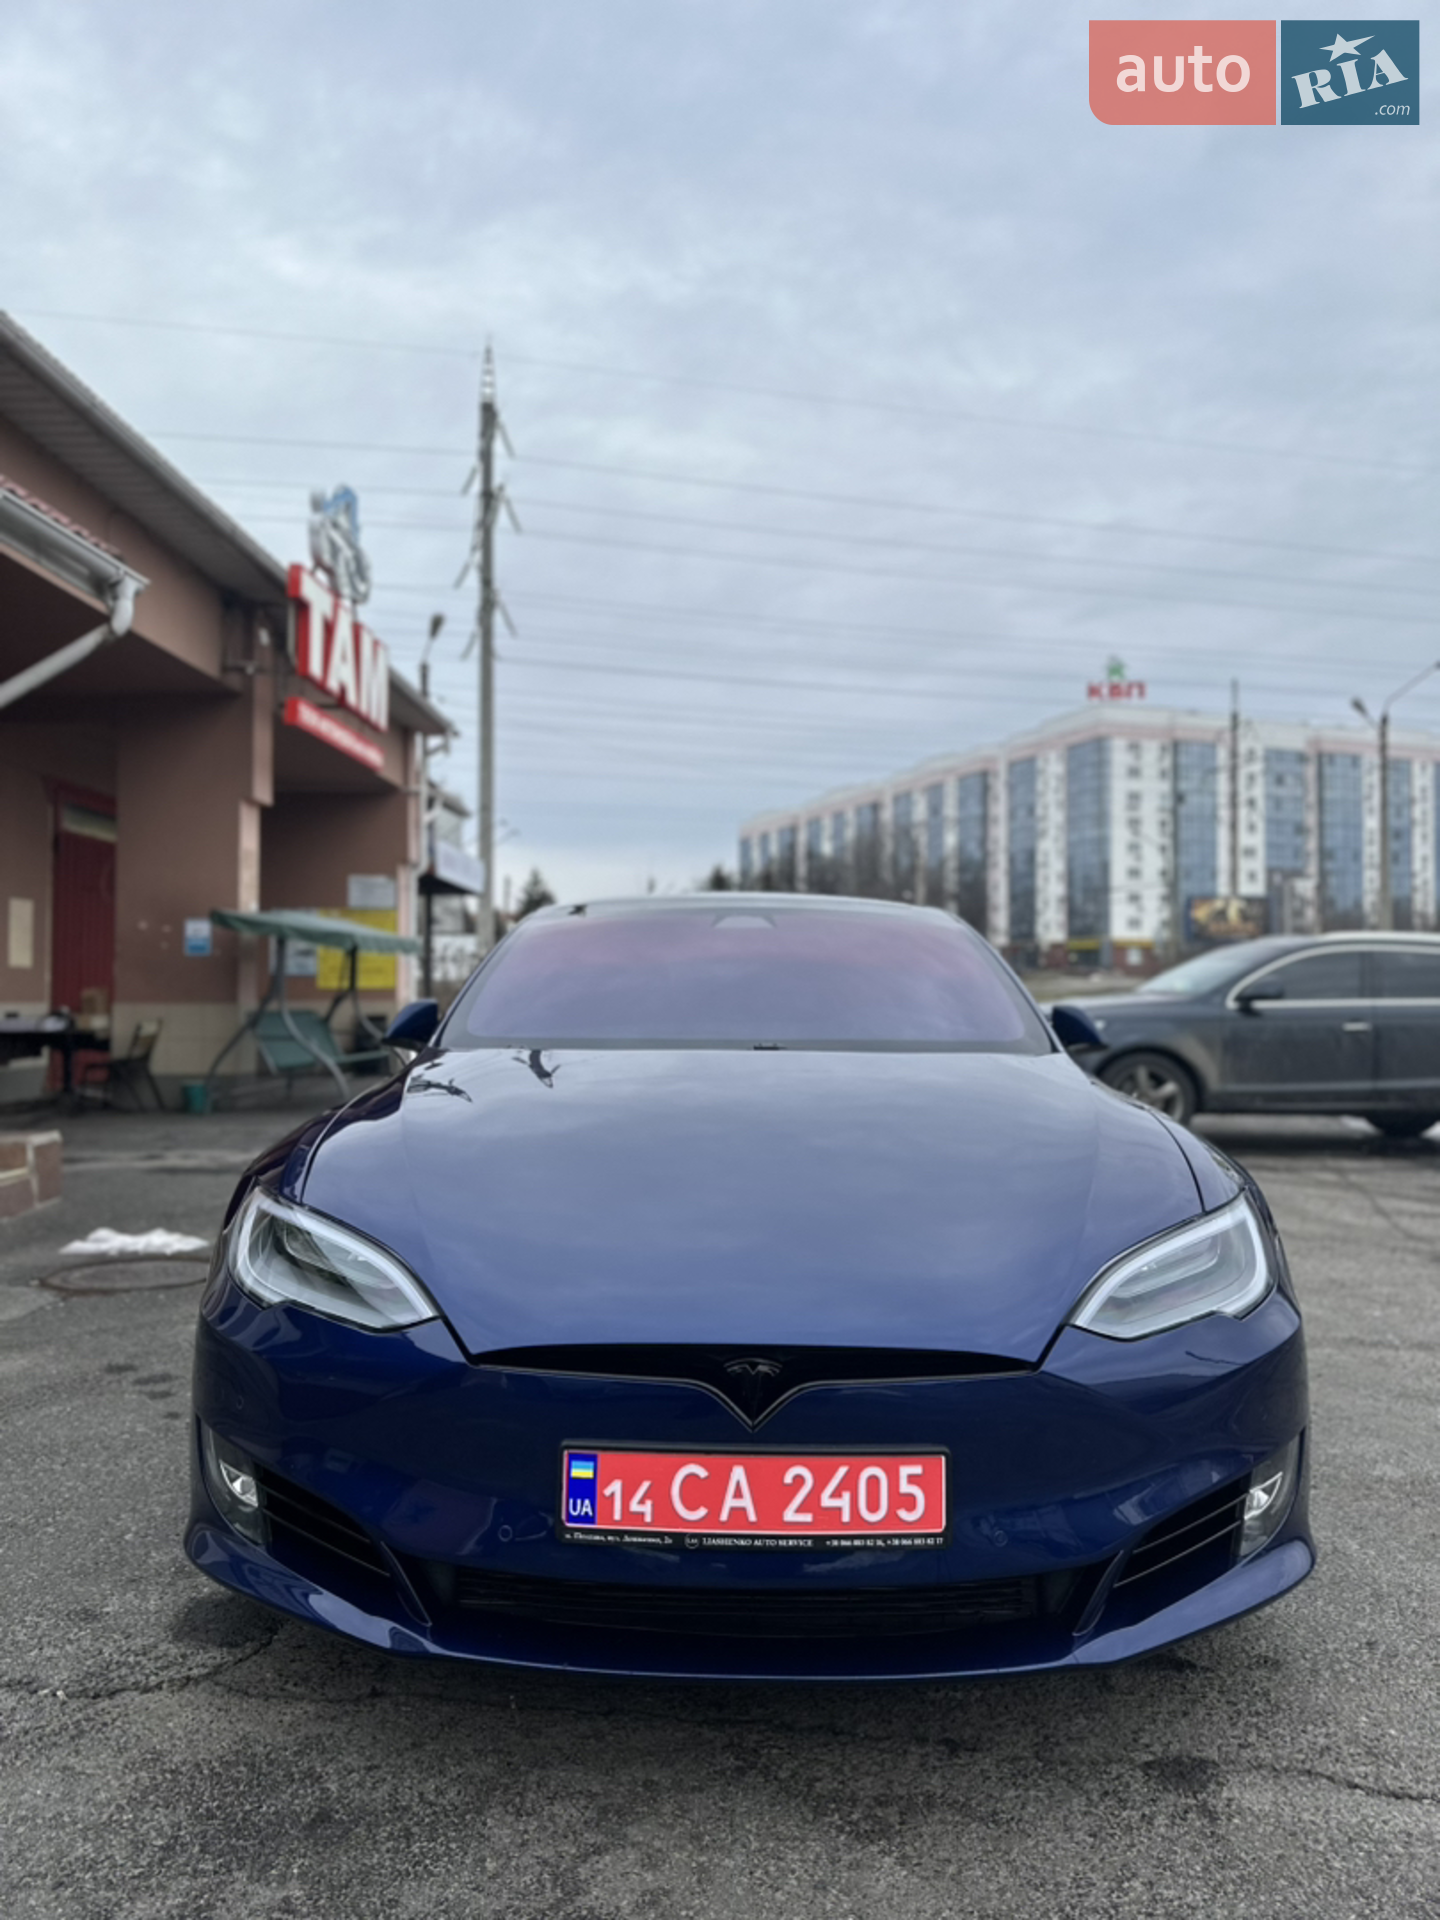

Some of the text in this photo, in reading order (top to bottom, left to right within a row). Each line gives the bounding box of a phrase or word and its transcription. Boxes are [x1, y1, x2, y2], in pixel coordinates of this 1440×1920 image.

[602, 1463, 926, 1524] 14 CA 2405
[568, 1498, 594, 1517] UA
[753, 1538, 778, 1547] AUTO
